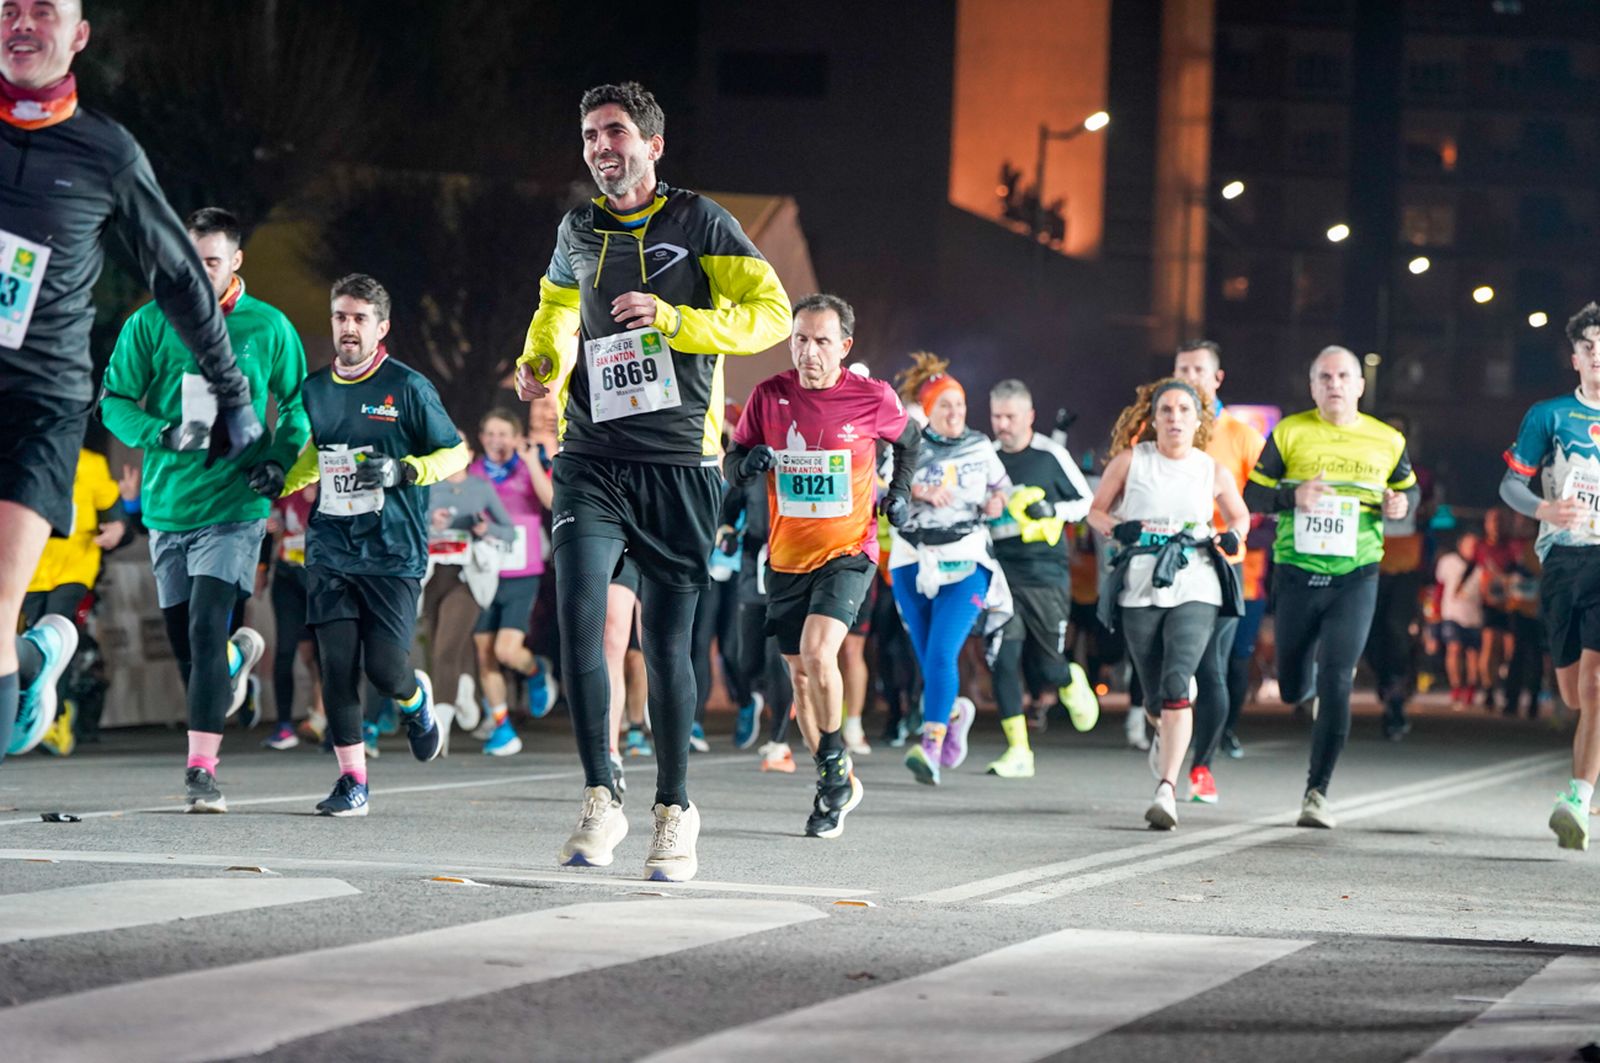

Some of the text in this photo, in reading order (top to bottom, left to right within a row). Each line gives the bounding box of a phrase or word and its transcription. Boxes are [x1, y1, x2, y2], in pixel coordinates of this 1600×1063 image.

[623, 340, 633, 350] DE
[596, 355, 609, 367] SAN
[602, 357, 658, 391] 6869
[783, 465, 797, 474] SAN
[334, 472, 363, 493] 622
[792, 474, 834, 495] 8121
[1304, 516, 1345, 534] 7596
